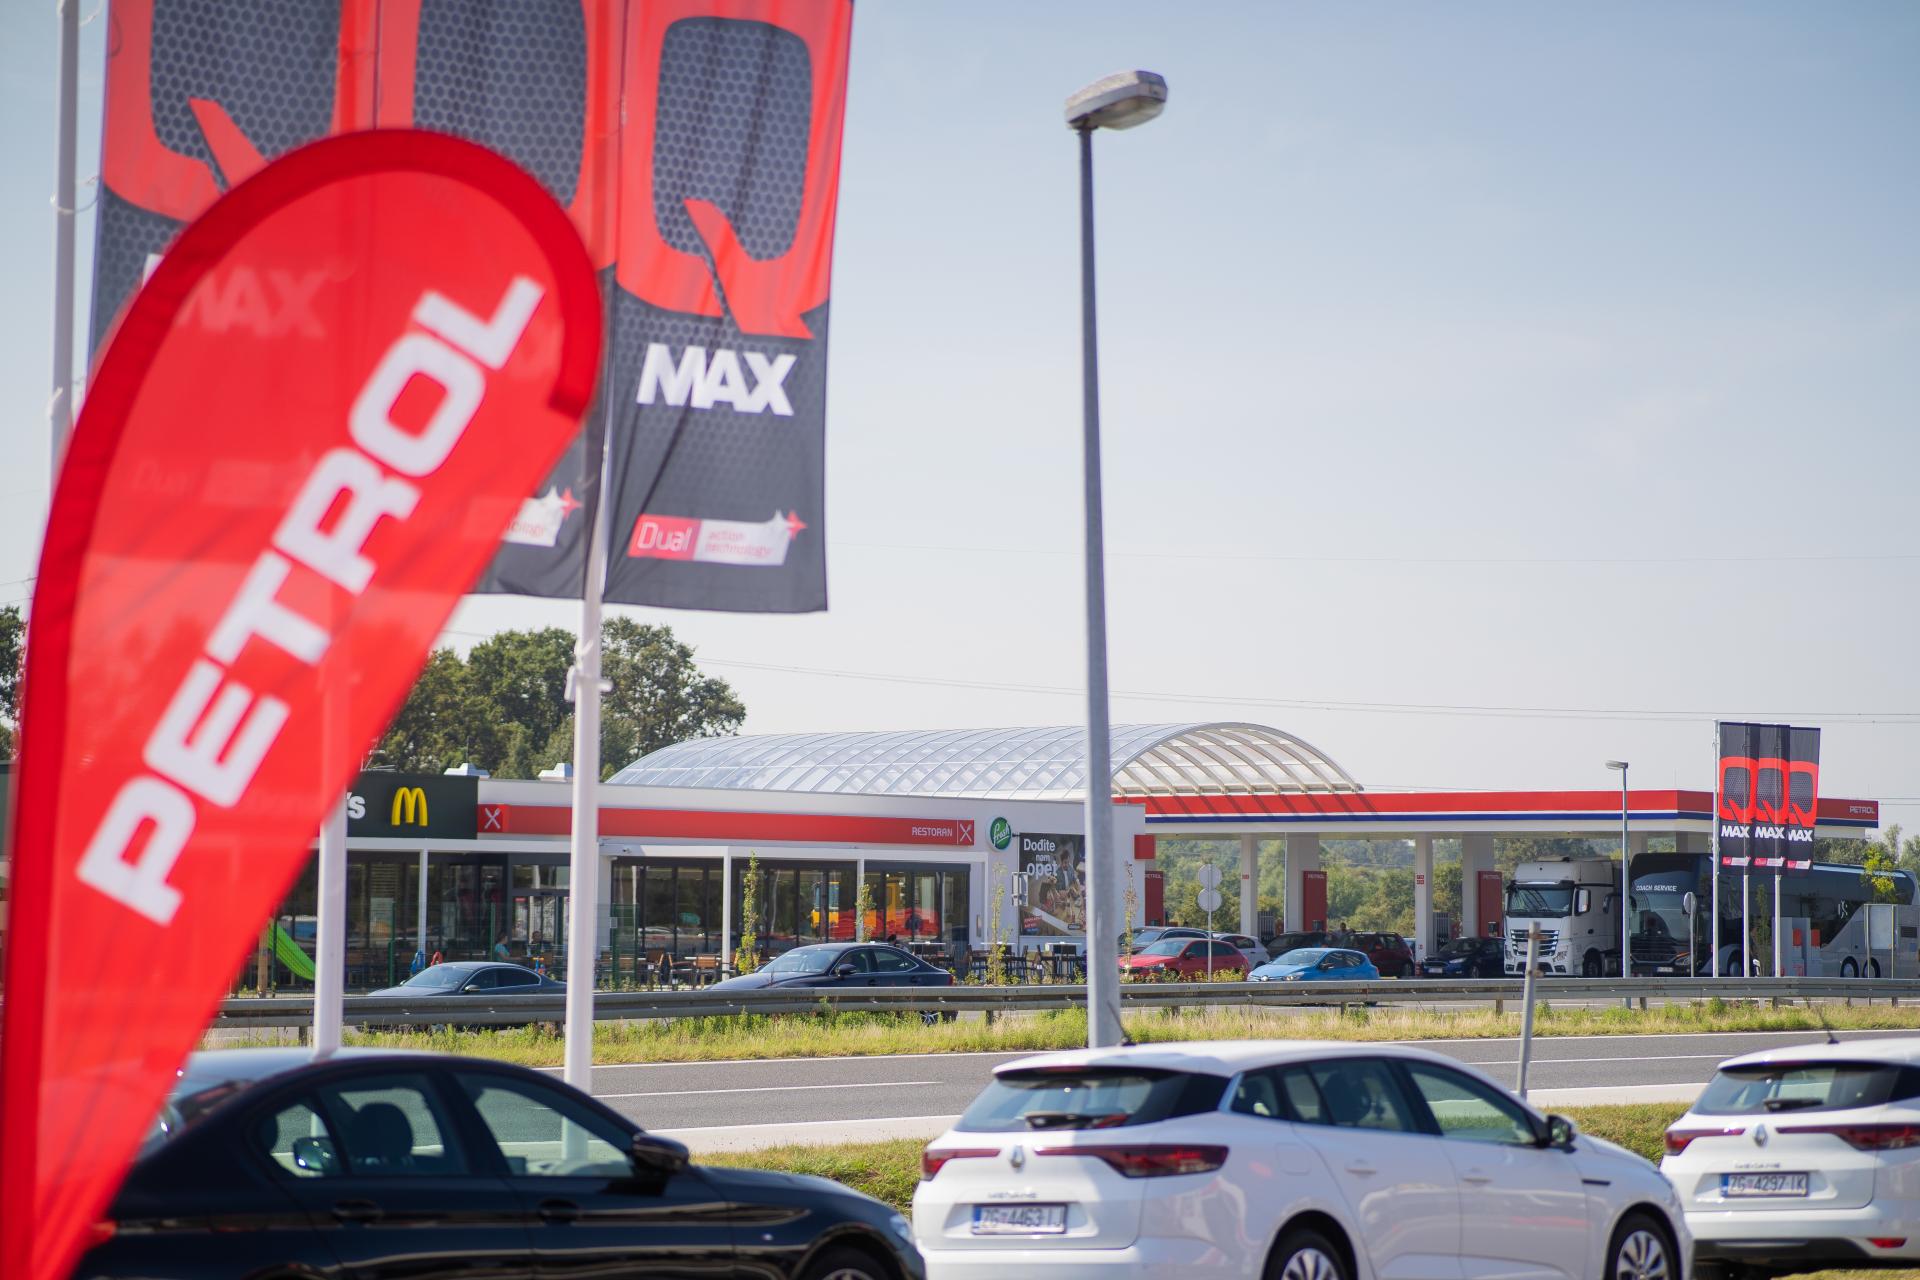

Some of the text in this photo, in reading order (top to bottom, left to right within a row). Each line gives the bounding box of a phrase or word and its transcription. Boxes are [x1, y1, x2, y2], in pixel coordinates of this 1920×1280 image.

[636, 342, 798, 417] MAX
[637, 521, 693, 553] Dual
[76, 275, 546, 926] PETROL
[1849, 805, 1876, 814] PETROL
[911, 826, 953, 838] RESTORAN
[993, 822, 1010, 848] fresh
[1721, 825, 1750, 838] MAX
[1754, 826, 1786, 839] MAX
[1023, 838, 1056, 852] Dođite
[1026, 860, 1058, 880] opet
